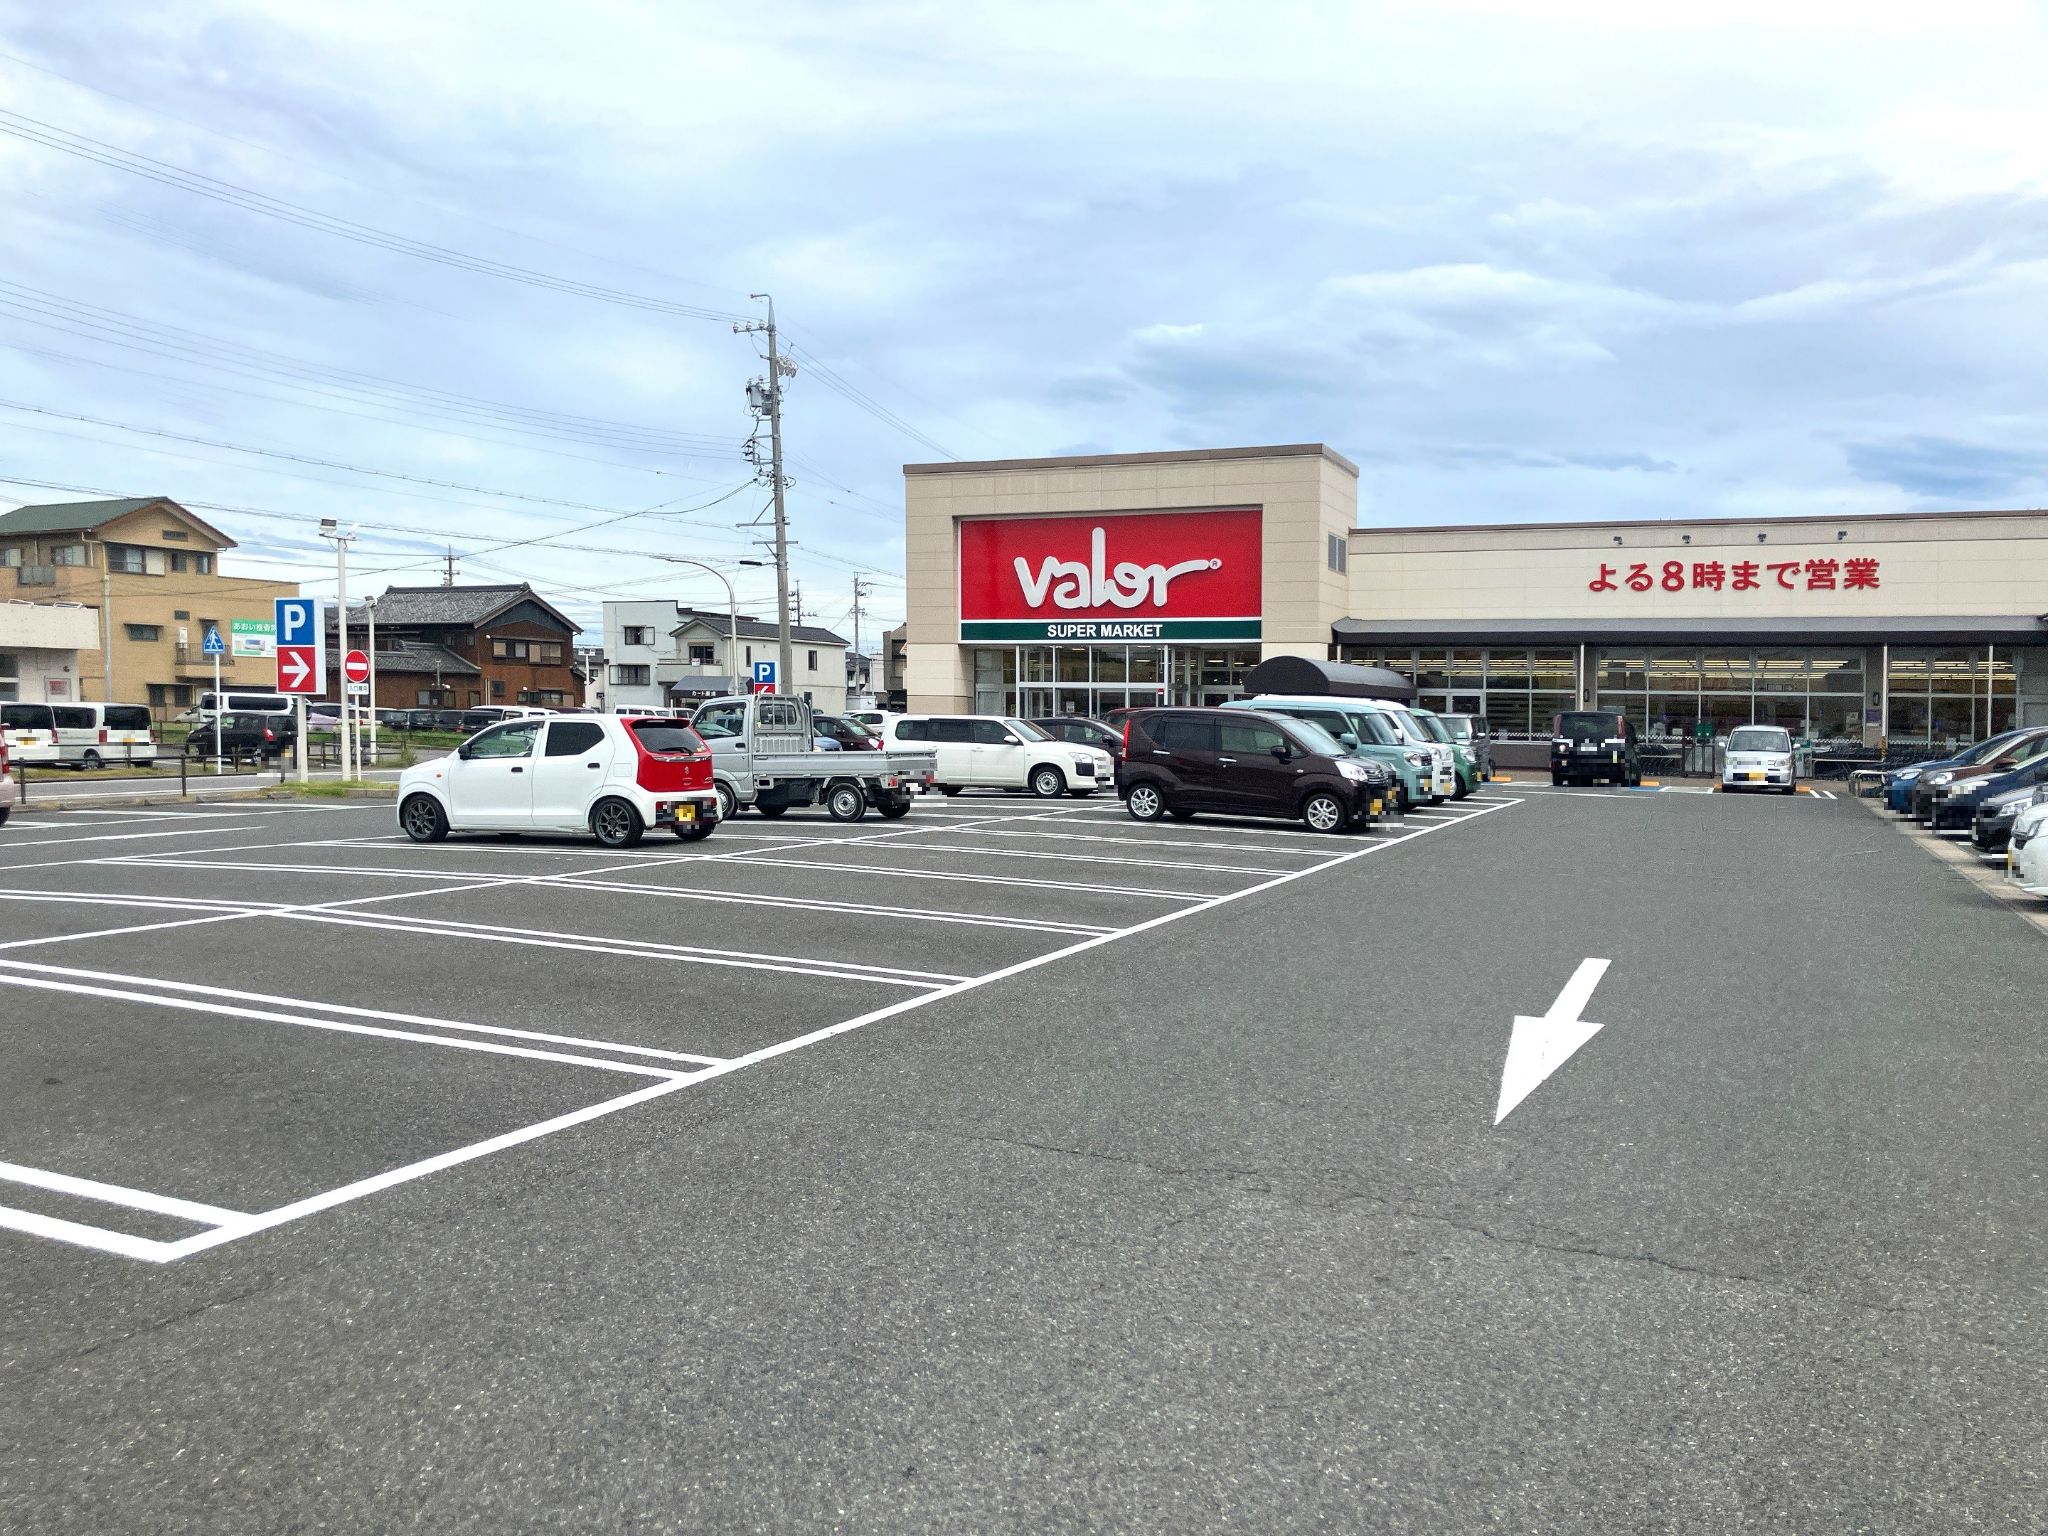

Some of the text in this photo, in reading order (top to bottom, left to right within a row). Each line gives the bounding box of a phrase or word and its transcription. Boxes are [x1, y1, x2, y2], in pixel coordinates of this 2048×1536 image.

[1013, 527, 1209, 609] valor
[1588, 558, 1880, 592] よる8時まで営業
[284, 604, 306, 641] P
[1047, 624, 1163, 638] SUPER MARKET
[759, 664, 771, 681] P
